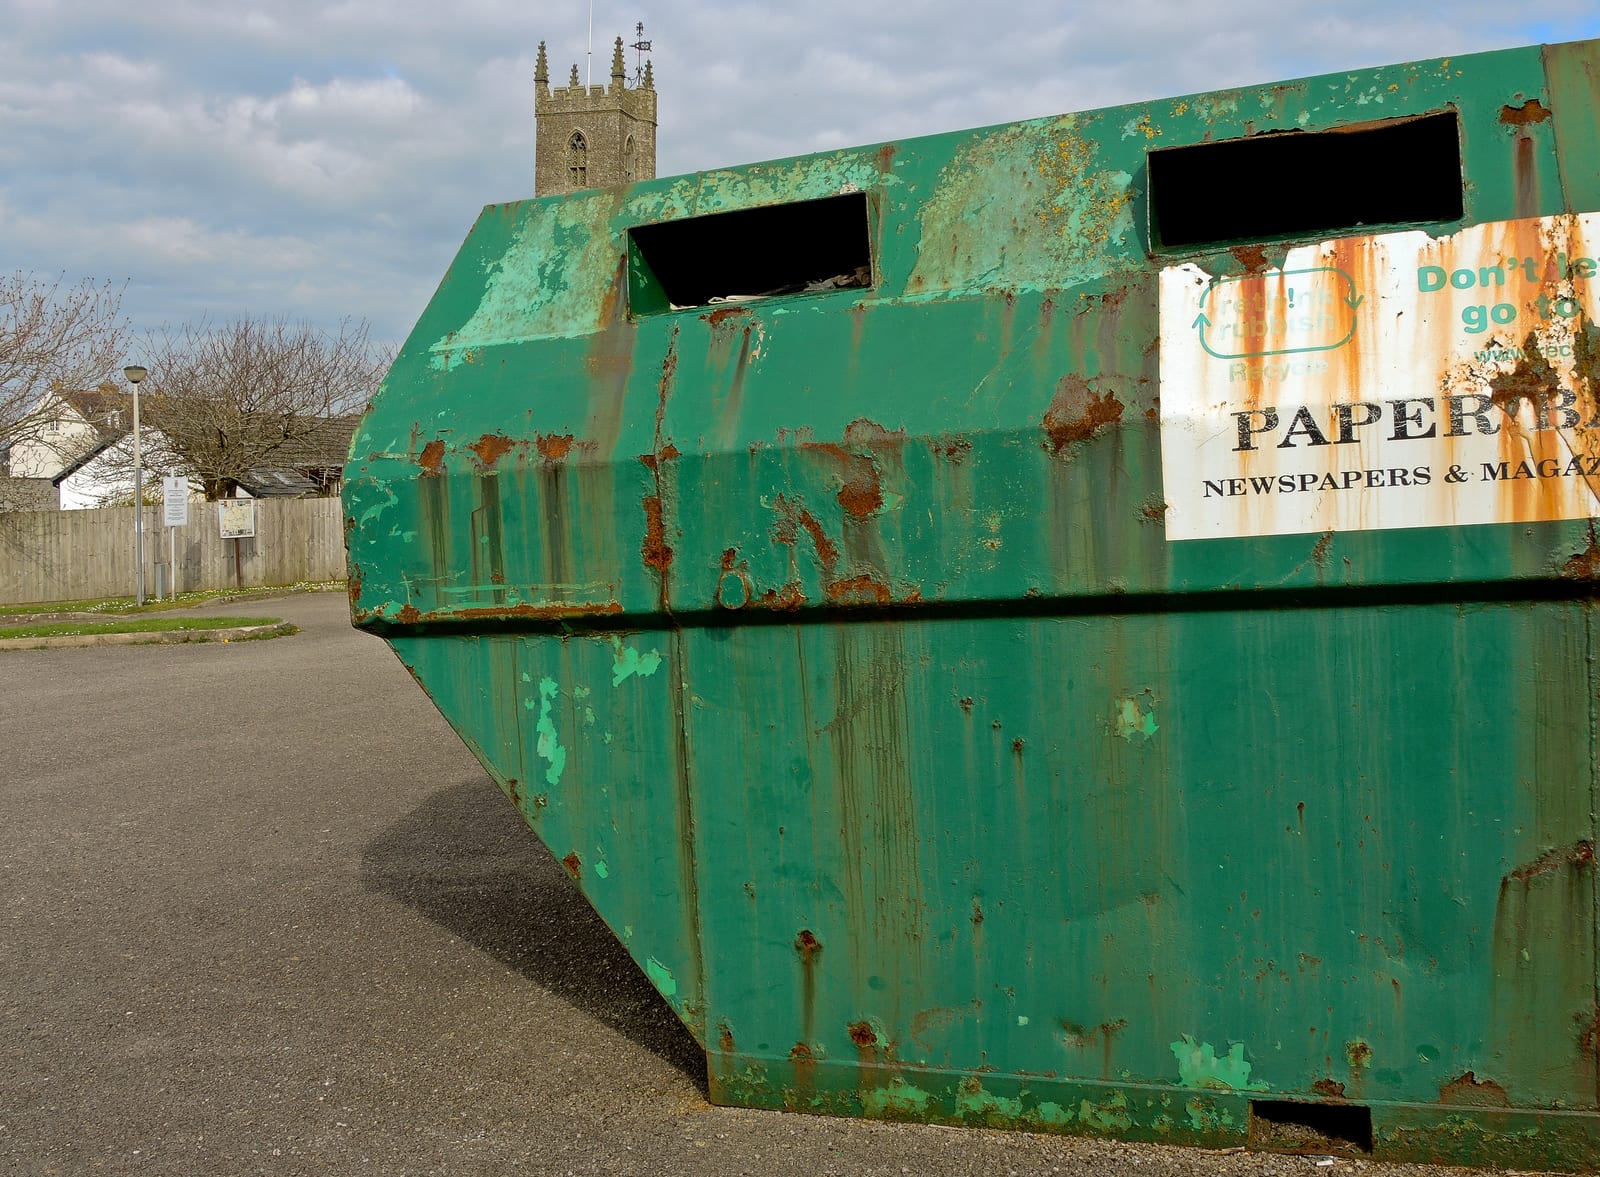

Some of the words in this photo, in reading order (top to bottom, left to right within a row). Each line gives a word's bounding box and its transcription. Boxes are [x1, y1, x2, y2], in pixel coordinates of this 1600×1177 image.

[1417, 256, 1541, 293] Don't
[1557, 251, 1600, 280] le
[1461, 303, 1518, 334] go
[1534, 293, 1581, 320] to
[1230, 393, 1502, 452] PAPER
[1202, 466, 1432, 498] NEWSPAPERS
[1443, 464, 1469, 484] &
